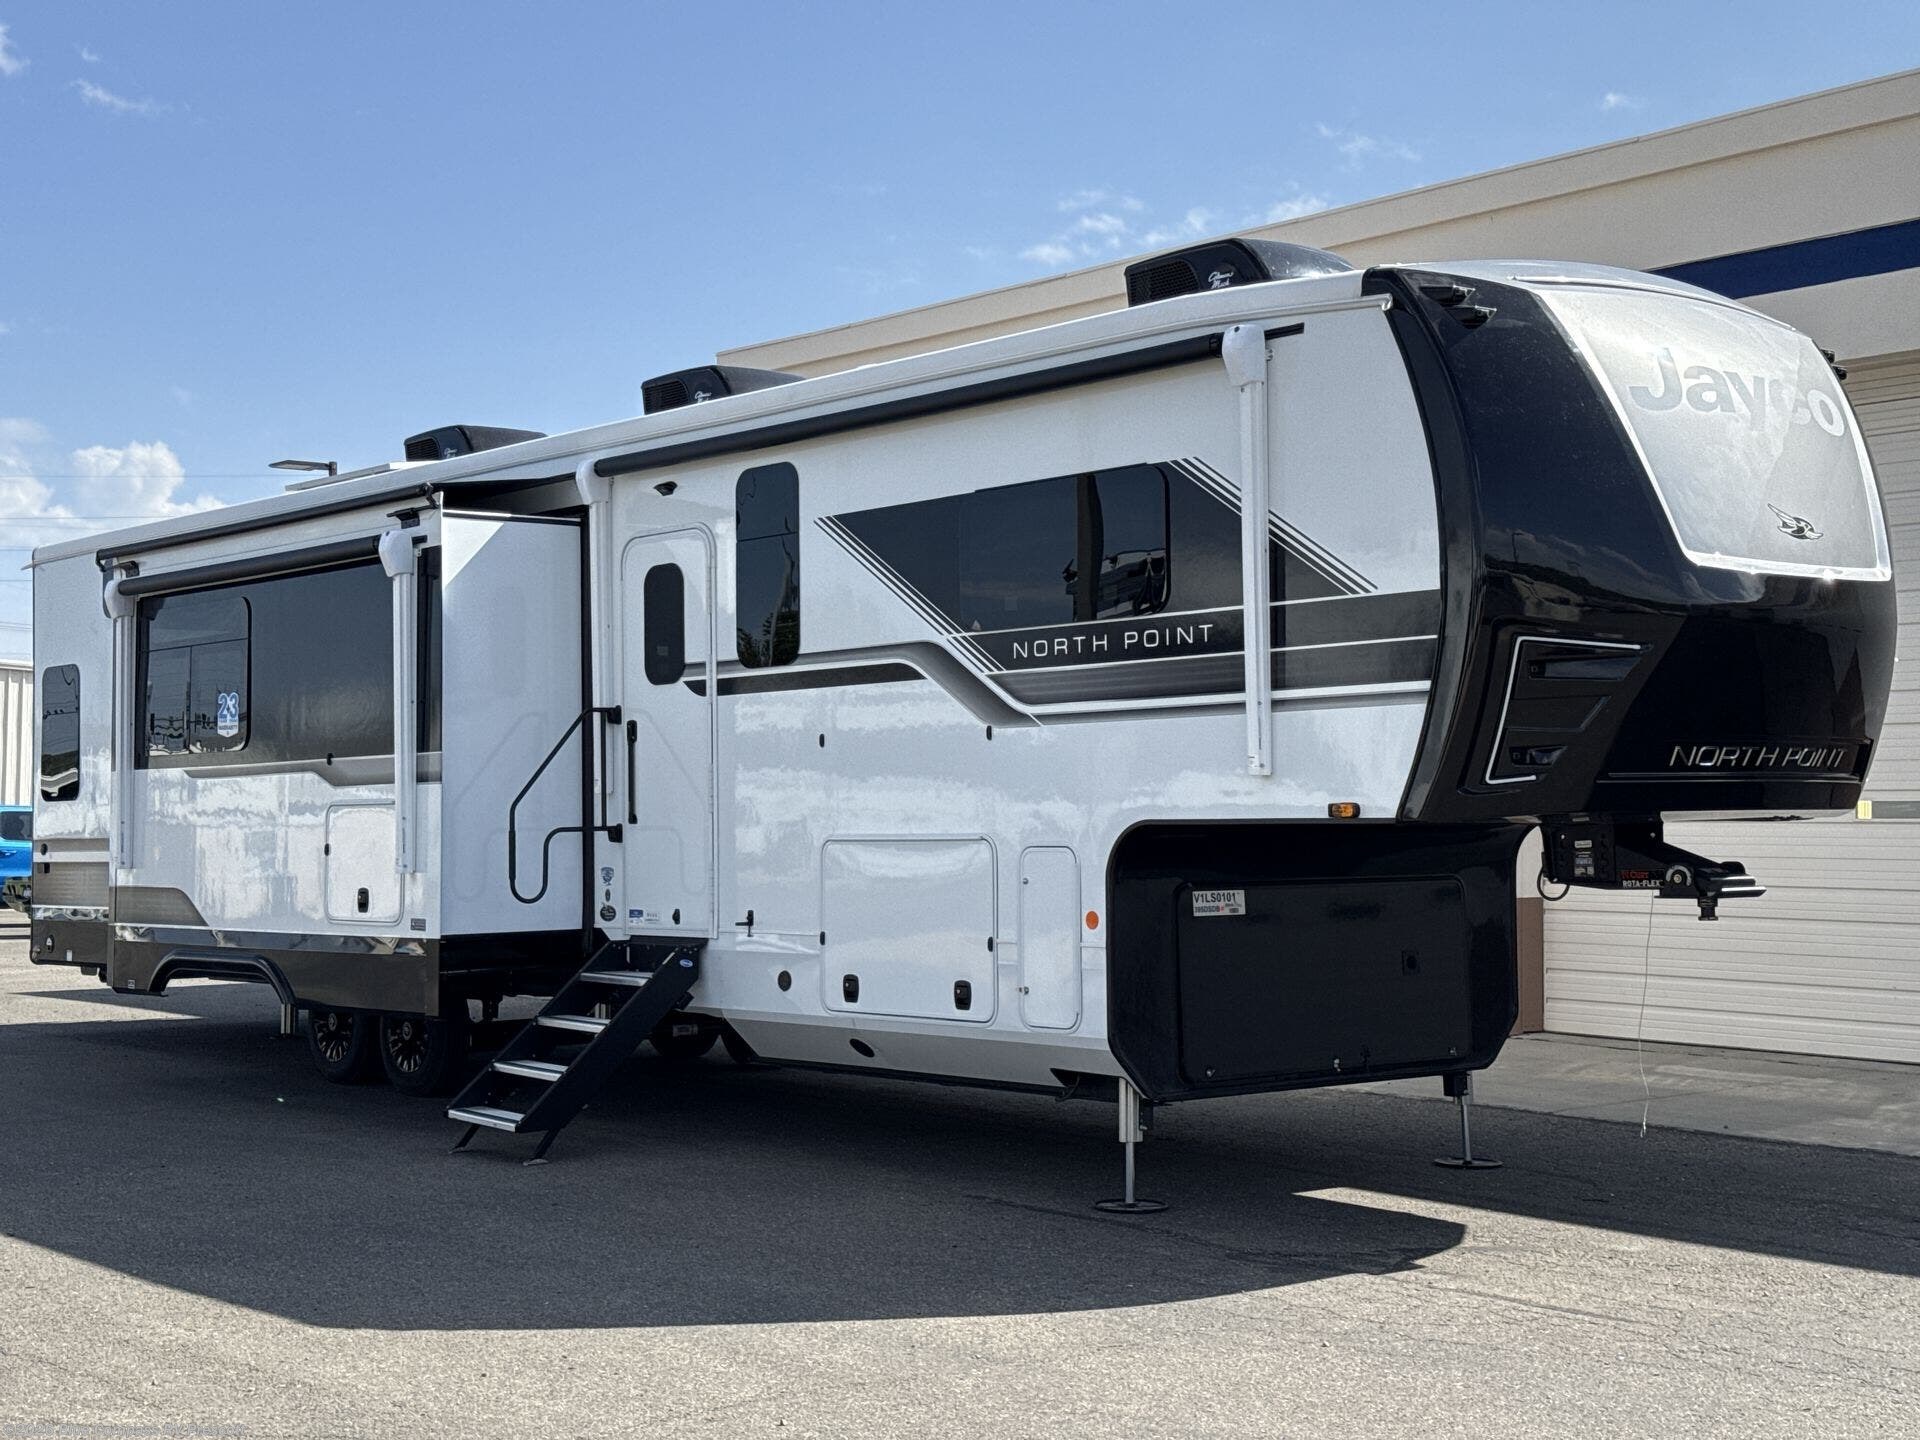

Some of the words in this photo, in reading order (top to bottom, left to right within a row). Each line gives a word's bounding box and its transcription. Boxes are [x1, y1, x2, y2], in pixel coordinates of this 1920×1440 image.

[1628, 347, 1845, 437] Jayco
[1013, 633, 1108, 659] NORTH
[1124, 624, 1214, 649] POINT
[1669, 745, 1780, 767] NORTH
[1781, 747, 1847, 768] POINT
[1622, 879, 1661, 889] ROTA-FLEX
[1193, 891, 1236, 903] V1LS0101
